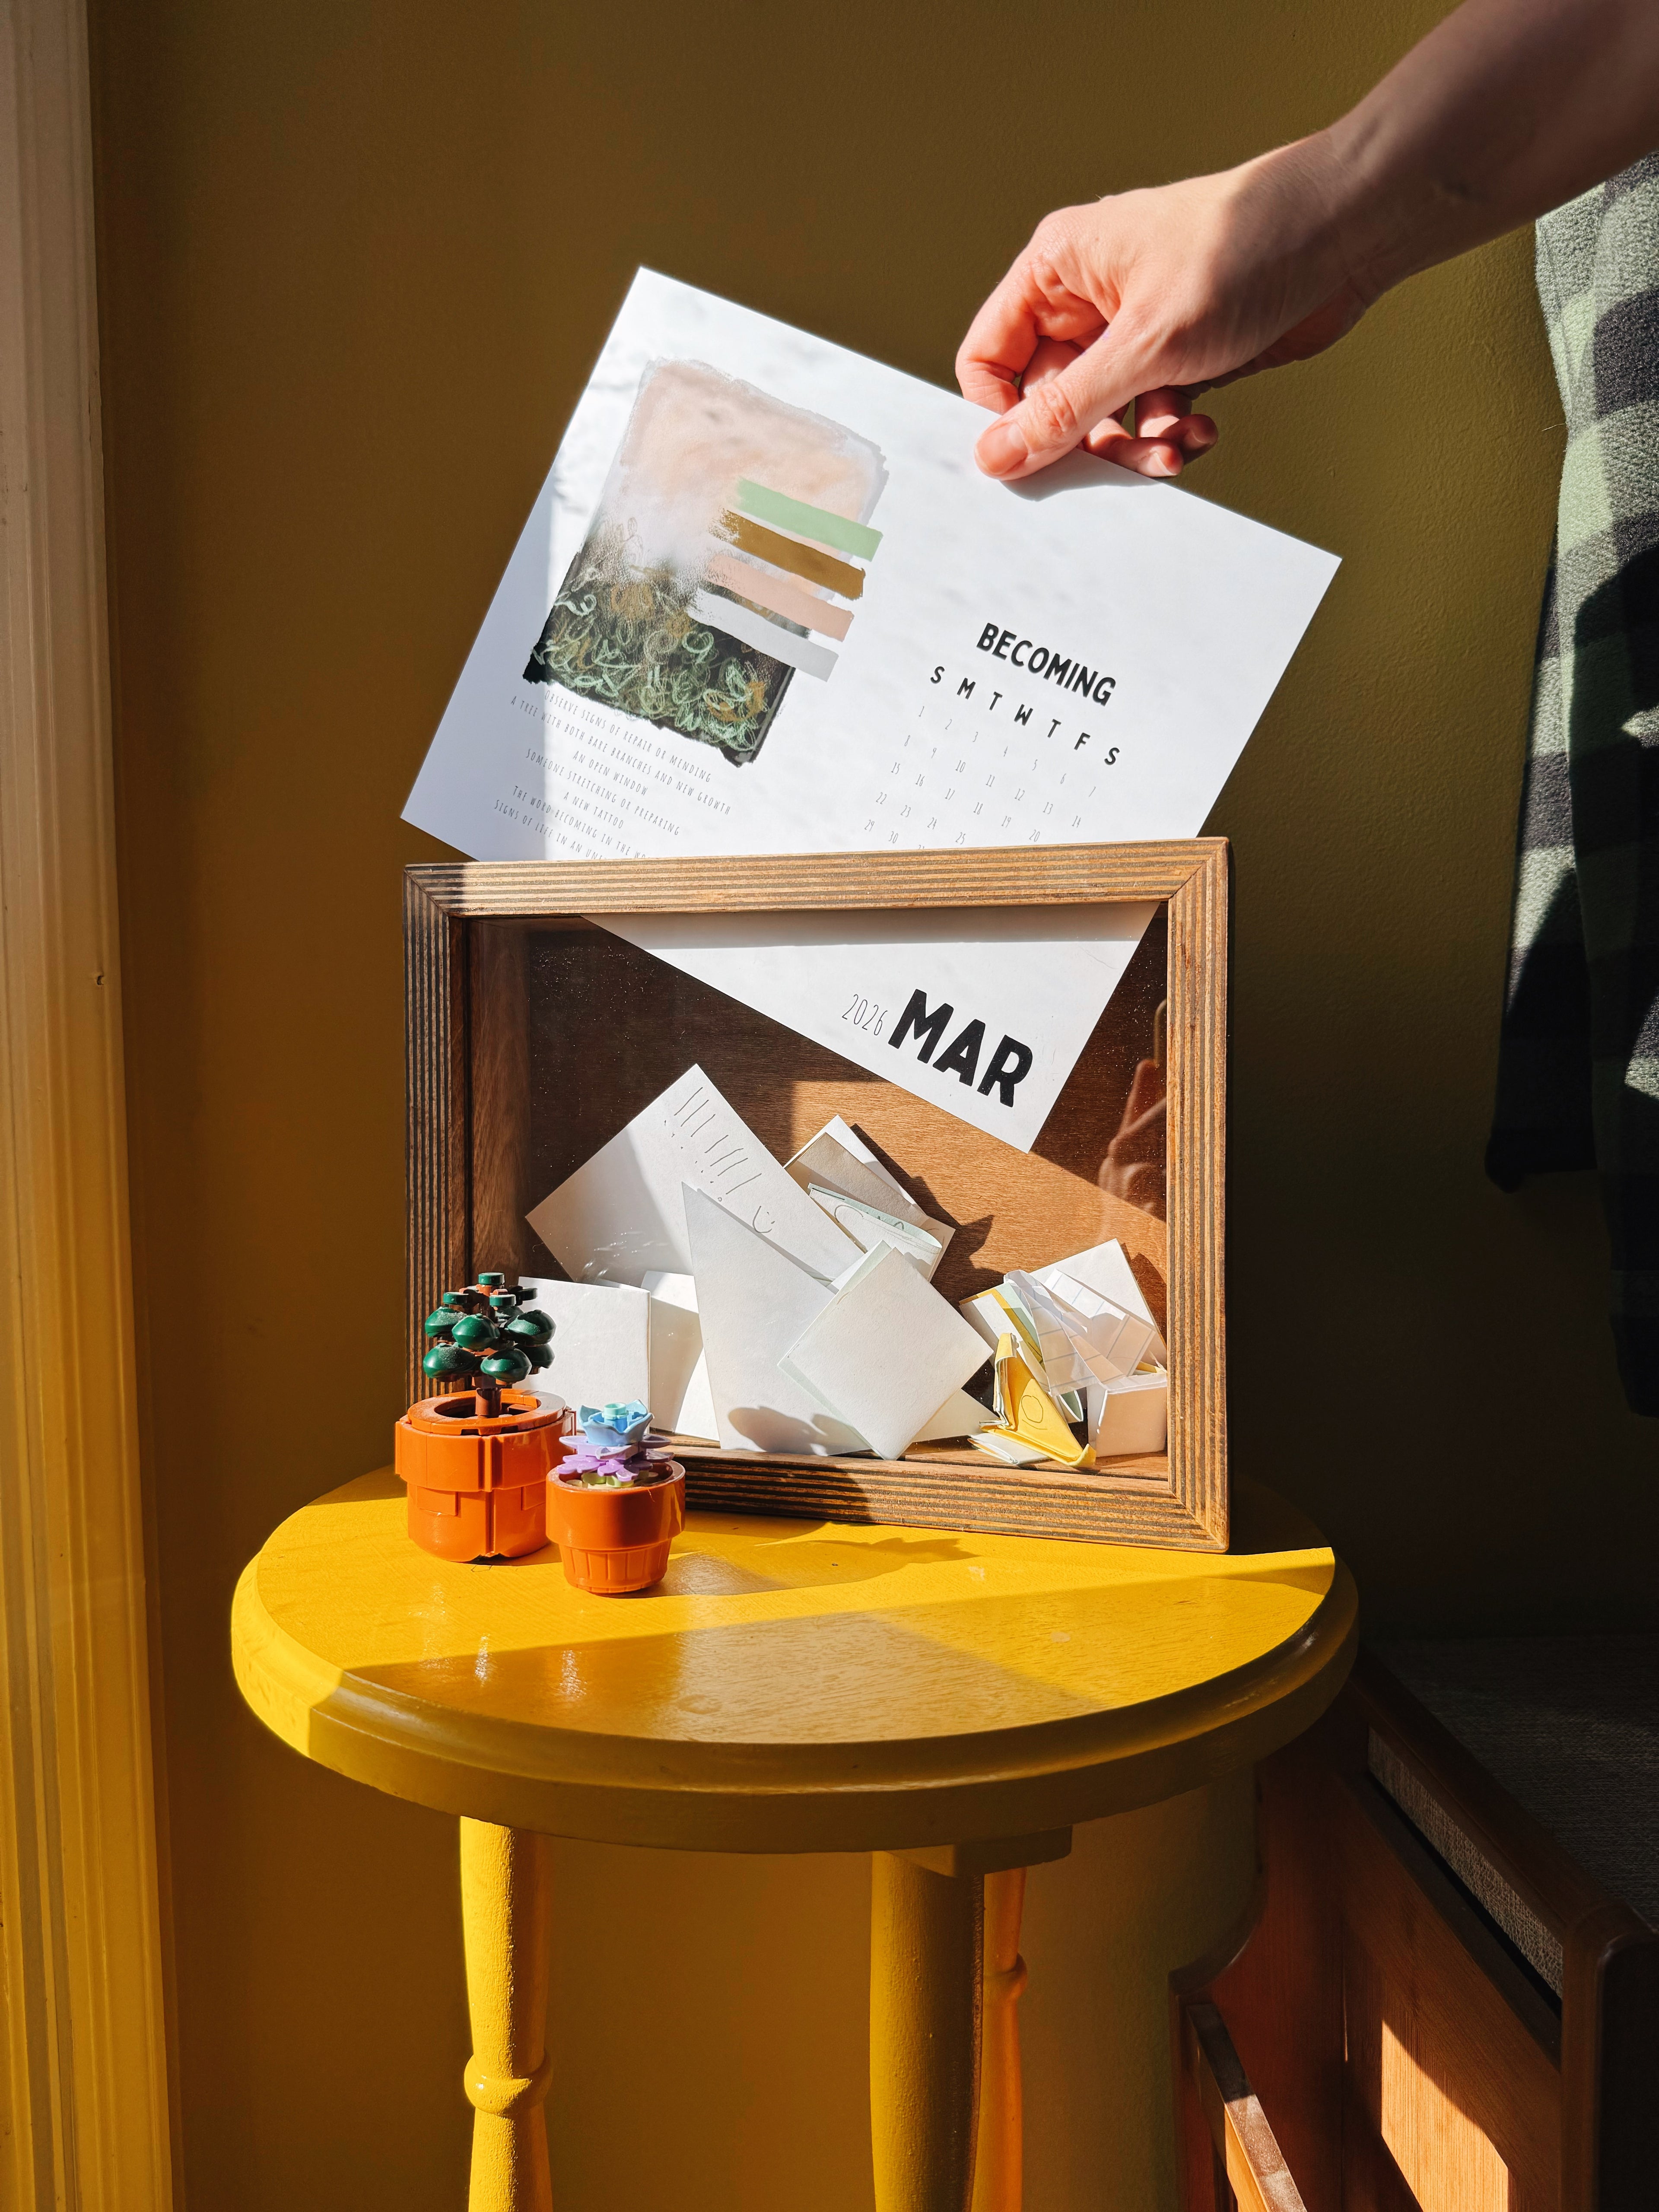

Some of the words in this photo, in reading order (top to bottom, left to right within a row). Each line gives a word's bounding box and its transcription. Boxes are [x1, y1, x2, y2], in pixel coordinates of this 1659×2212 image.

[976, 623, 1116, 706] BECOMING
[511, 696, 517, 706] A
[520, 700, 538, 717] TREE
[541, 713, 562, 728] WITH
[564, 724, 585, 741] BOTH
[588, 736, 608, 753] BARE
[610, 747, 652, 775] BRANCHES
[655, 770, 672, 785] AND
[676, 781, 694, 797] NEW
[697, 792, 731, 815] GROWTH
[545, 690, 578, 715] OBSERVE
[581, 709, 606, 729] SIGNS
[610, 724, 620, 736] OF
[623, 731, 652, 753] REPAIR
[655, 747, 666, 760] OR
[669, 755, 711, 782] MENDING
[918, 706, 925, 717] 1
[945, 718, 953, 730] 2
[972, 731, 979, 743] 3
[1003, 746, 1008, 757] 4
[1032, 759, 1038, 771] 5
[1060, 773, 1067, 785] 6
[1088, 786, 1096, 798] 7
[930, 666, 945, 683] S
[957, 678, 976, 699] M
[989, 692, 1003, 710] T
[1014, 704, 1033, 725] W
[1048, 719, 1061, 737] T
[1074, 732, 1090, 750] F
[1105, 747, 1120, 765] S
[526, 748, 564, 776] SOMEONE
[567, 771, 617, 803] STRETCHING
[620, 798, 631, 810] OR
[634, 806, 680, 836] PREPARING
[563, 791, 569, 800] A
[572, 796, 590, 811] NEW
[593, 806, 623, 829] TATTOO
[572, 750, 586, 763] AN
[588, 759, 610, 776] OPEN
[613, 772, 648, 796] WINDOW
[890, 762, 901, 775] 15
[915, 774, 925, 787] 16
[944, 788, 955, 801] 17
[973, 802, 983, 815] 18
[1001, 815, 1011, 828] 19
[1029, 829, 1040, 842] 20
[904, 734, 911, 747] 8
[931, 747, 937, 759] 9
[955, 760, 966, 773] 10
[985, 774, 995, 787] 11
[1014, 788, 1025, 801] 12
[1042, 801, 1053, 815] 13
[1071, 815, 1081, 828] 14
[494, 799, 519, 820] SIGNS
[522, 815, 533, 826] OF
[535, 823, 553, 838] LIFE
[556, 833, 568, 845] IN
[570, 841, 582, 853] AN
[513, 785, 527, 801] THE
[530, 797, 551, 814] WORD
[555, 809, 597, 838] BECOMING
[601, 833, 613, 845] IN
[616, 841, 631, 855] THE
[864, 819, 875, 832] 29
[888, 831, 899, 844] 30
[875, 791, 887, 805] 22
[900, 804, 911, 818] 23
[927, 817, 937, 830] 24
[955, 832, 966, 845] 25
[842, 994, 888, 1036] 2026
[888, 988, 1033, 1108] MAR
